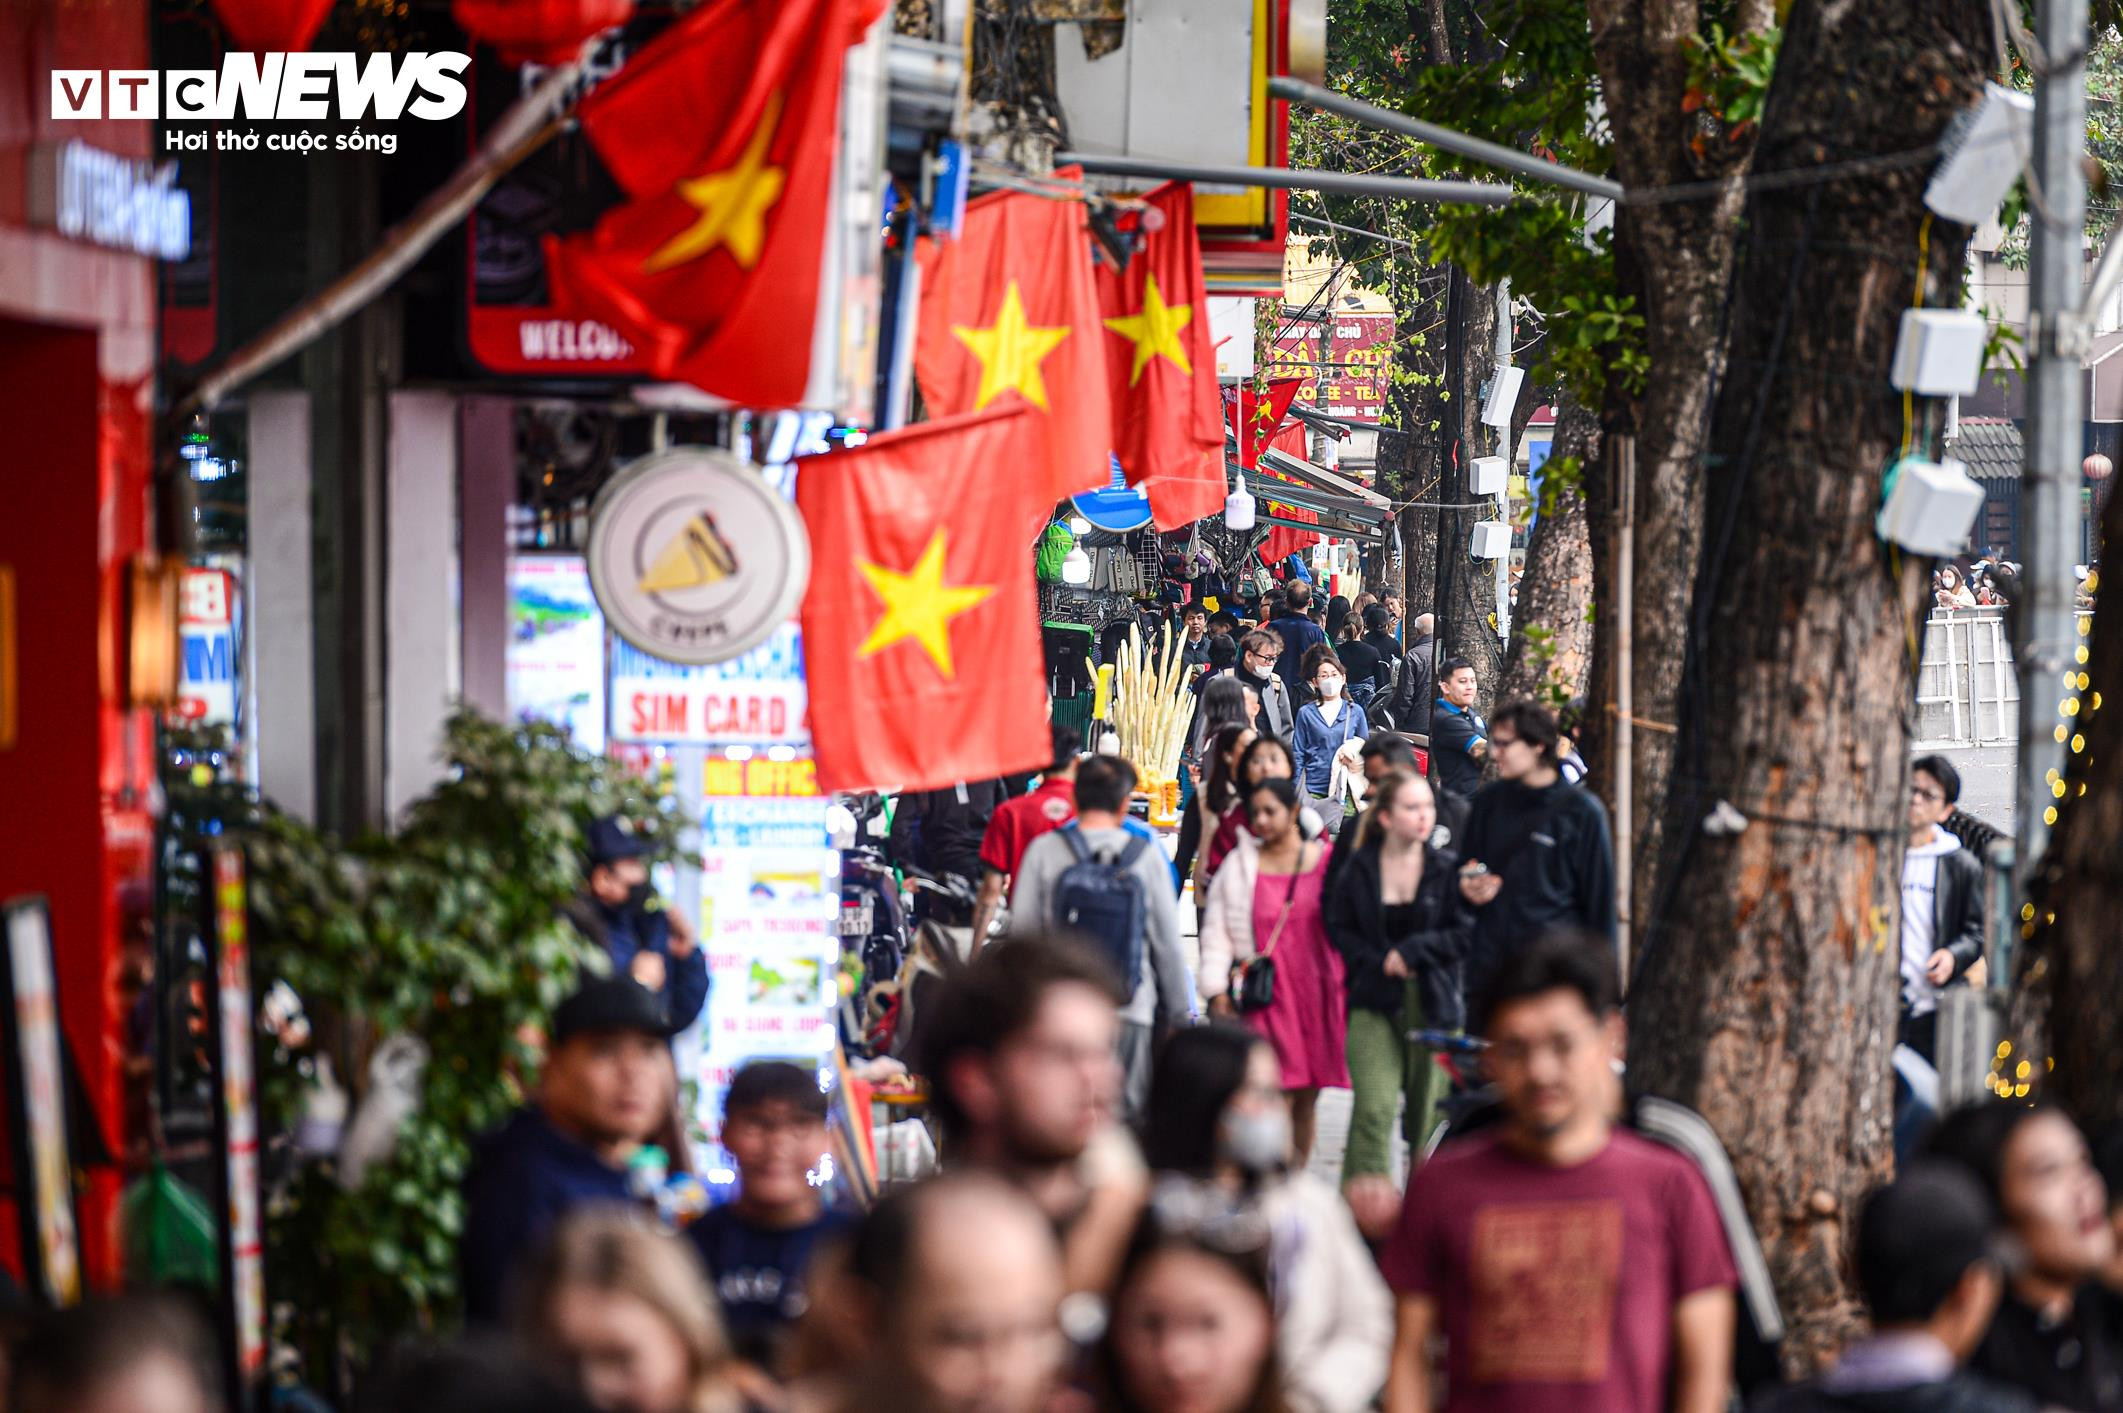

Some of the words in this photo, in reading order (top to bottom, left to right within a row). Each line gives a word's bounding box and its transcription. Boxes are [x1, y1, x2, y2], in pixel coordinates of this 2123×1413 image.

[1295, 385, 1341, 401] COEE
[631, 692, 688, 735] SIM
[704, 694, 787, 737] CARD
